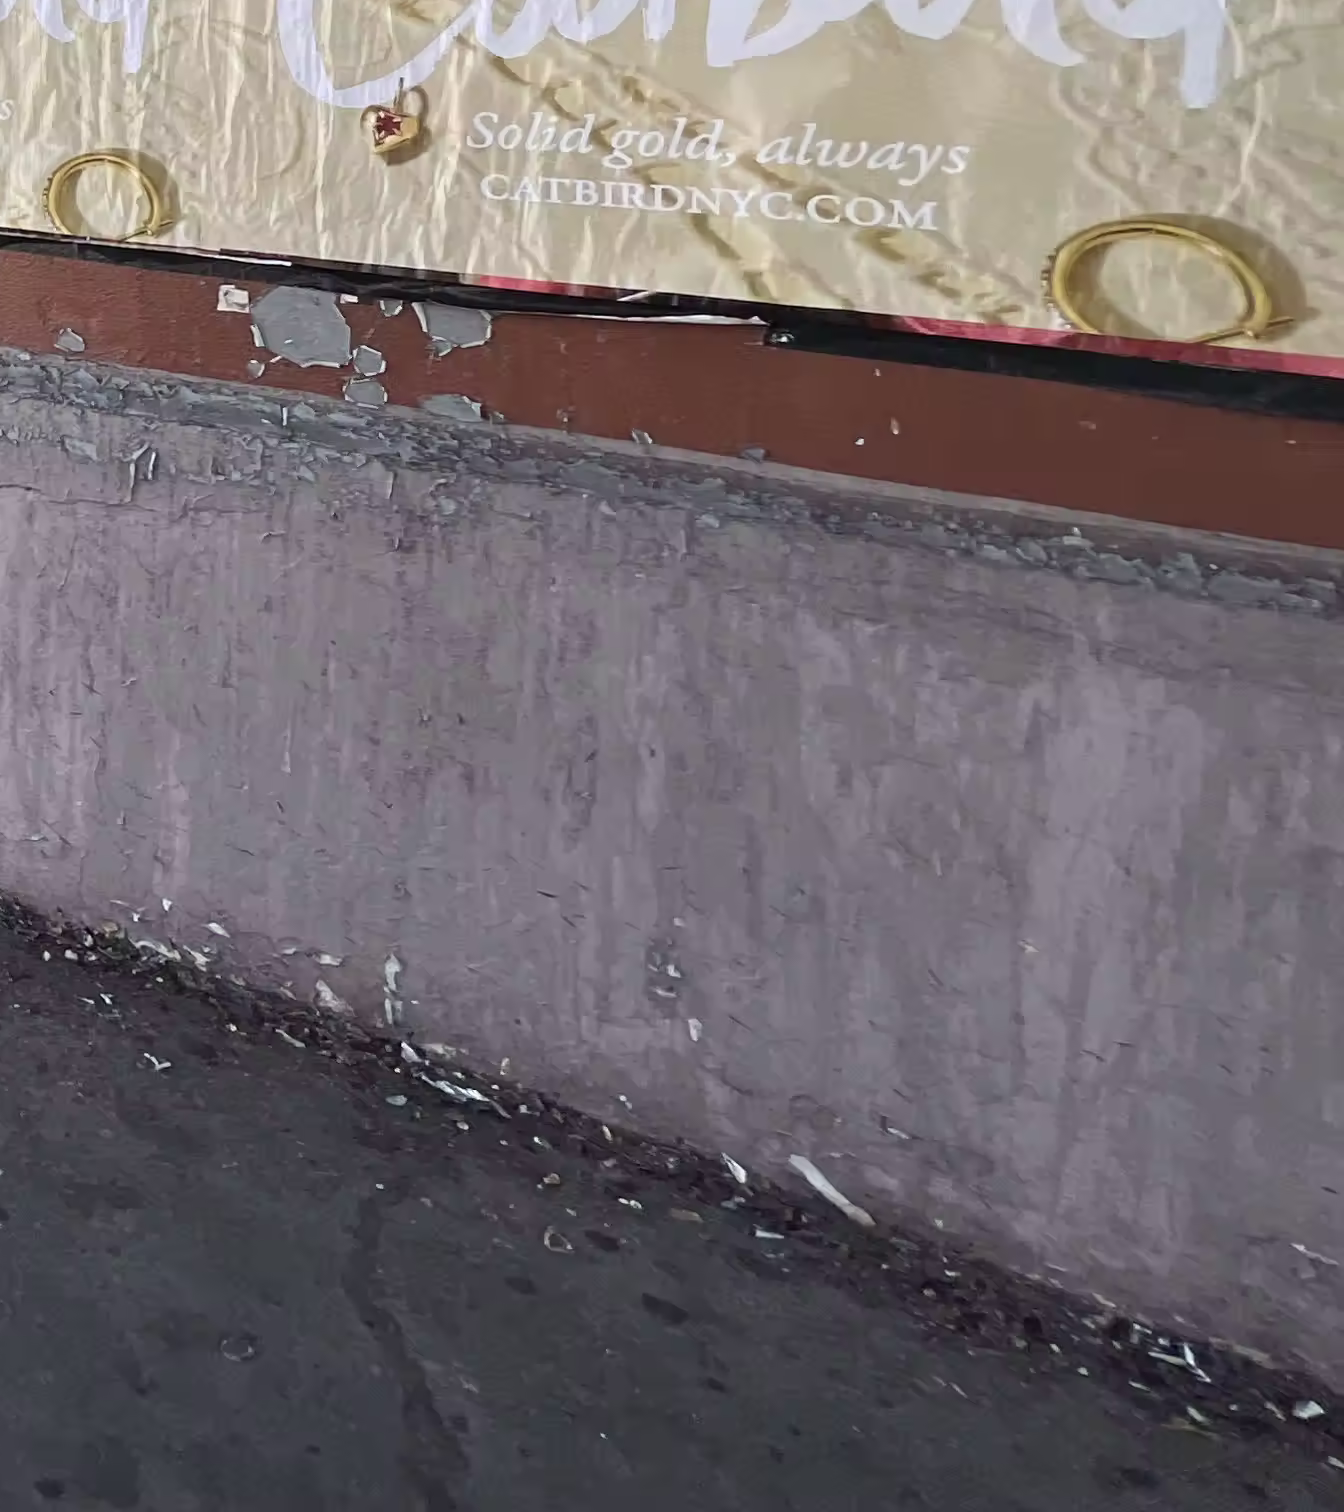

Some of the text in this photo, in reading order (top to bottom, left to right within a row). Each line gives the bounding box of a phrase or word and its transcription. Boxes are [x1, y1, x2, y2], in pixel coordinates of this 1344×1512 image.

[466, 111, 971, 186] Solid gold, always
[479, 172, 939, 232] CATBIRDNYC.COM
